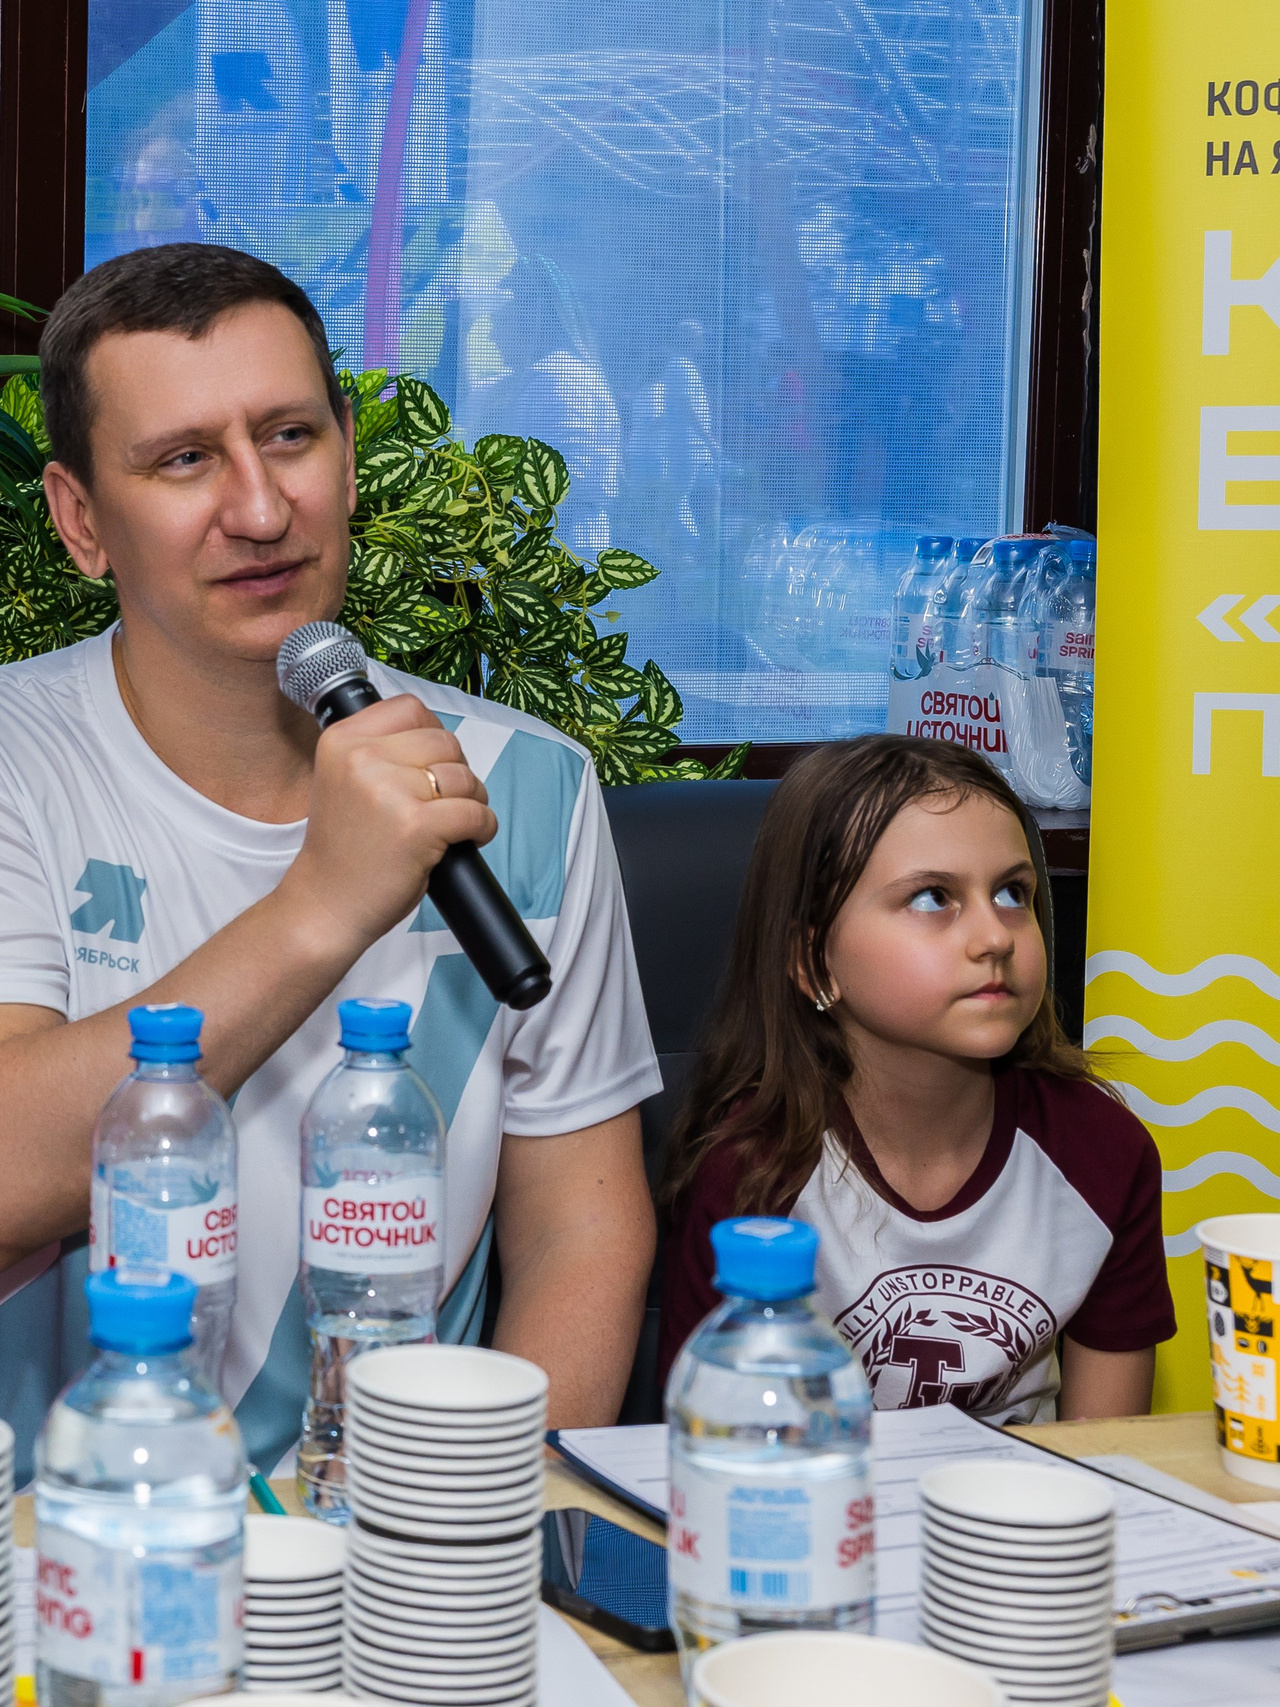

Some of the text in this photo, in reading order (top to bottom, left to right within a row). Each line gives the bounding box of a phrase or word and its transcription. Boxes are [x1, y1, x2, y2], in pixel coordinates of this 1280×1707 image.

[1206, 140, 1259, 176] НА
[921, 690, 1001, 722] СВЯТОЙ
[75, 946, 140, 974] ЯБРЬСК
[324, 1196, 426, 1222] СВЯТОЙ
[309, 1220, 438, 1247] ИСТОЧНИК
[878, 1272, 1038, 1320] UNSTOPPABLE
